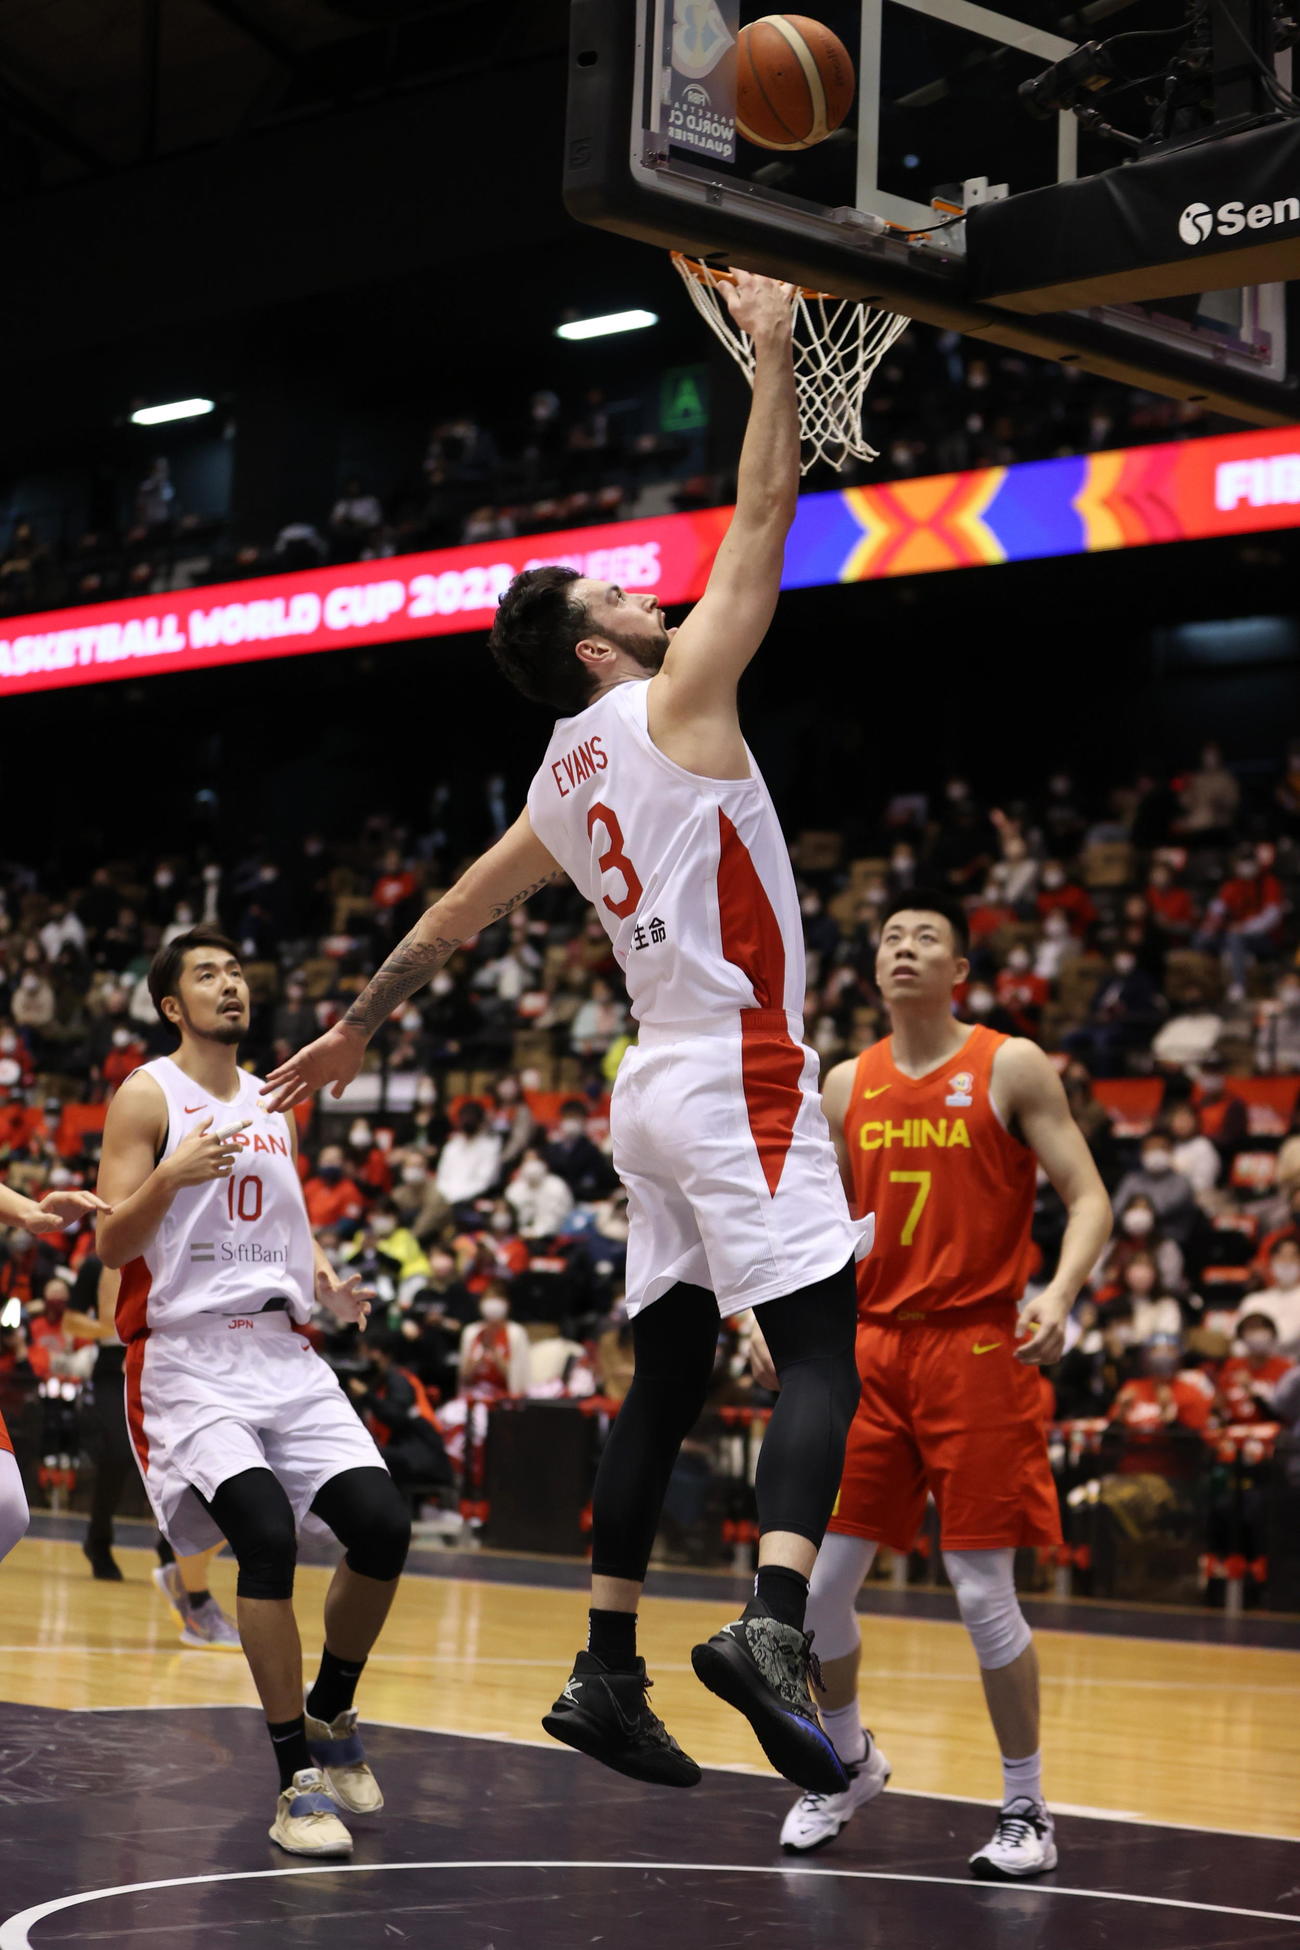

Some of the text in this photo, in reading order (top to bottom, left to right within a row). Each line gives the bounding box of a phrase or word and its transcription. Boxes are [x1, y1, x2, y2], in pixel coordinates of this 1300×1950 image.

[1216, 197, 1300, 236] Sen
[188, 590, 322, 650] WORLD
[323, 579, 406, 632] CUP
[551, 735, 608, 798] EVANS
[586, 801, 643, 920] 3
[859, 1117, 971, 1151] CHINA
[227, 1174, 263, 1222] 10
[889, 1170, 931, 1246] 7
[221, 1241, 288, 1264] SftBan
[228, 1318, 254, 1331] JPN
